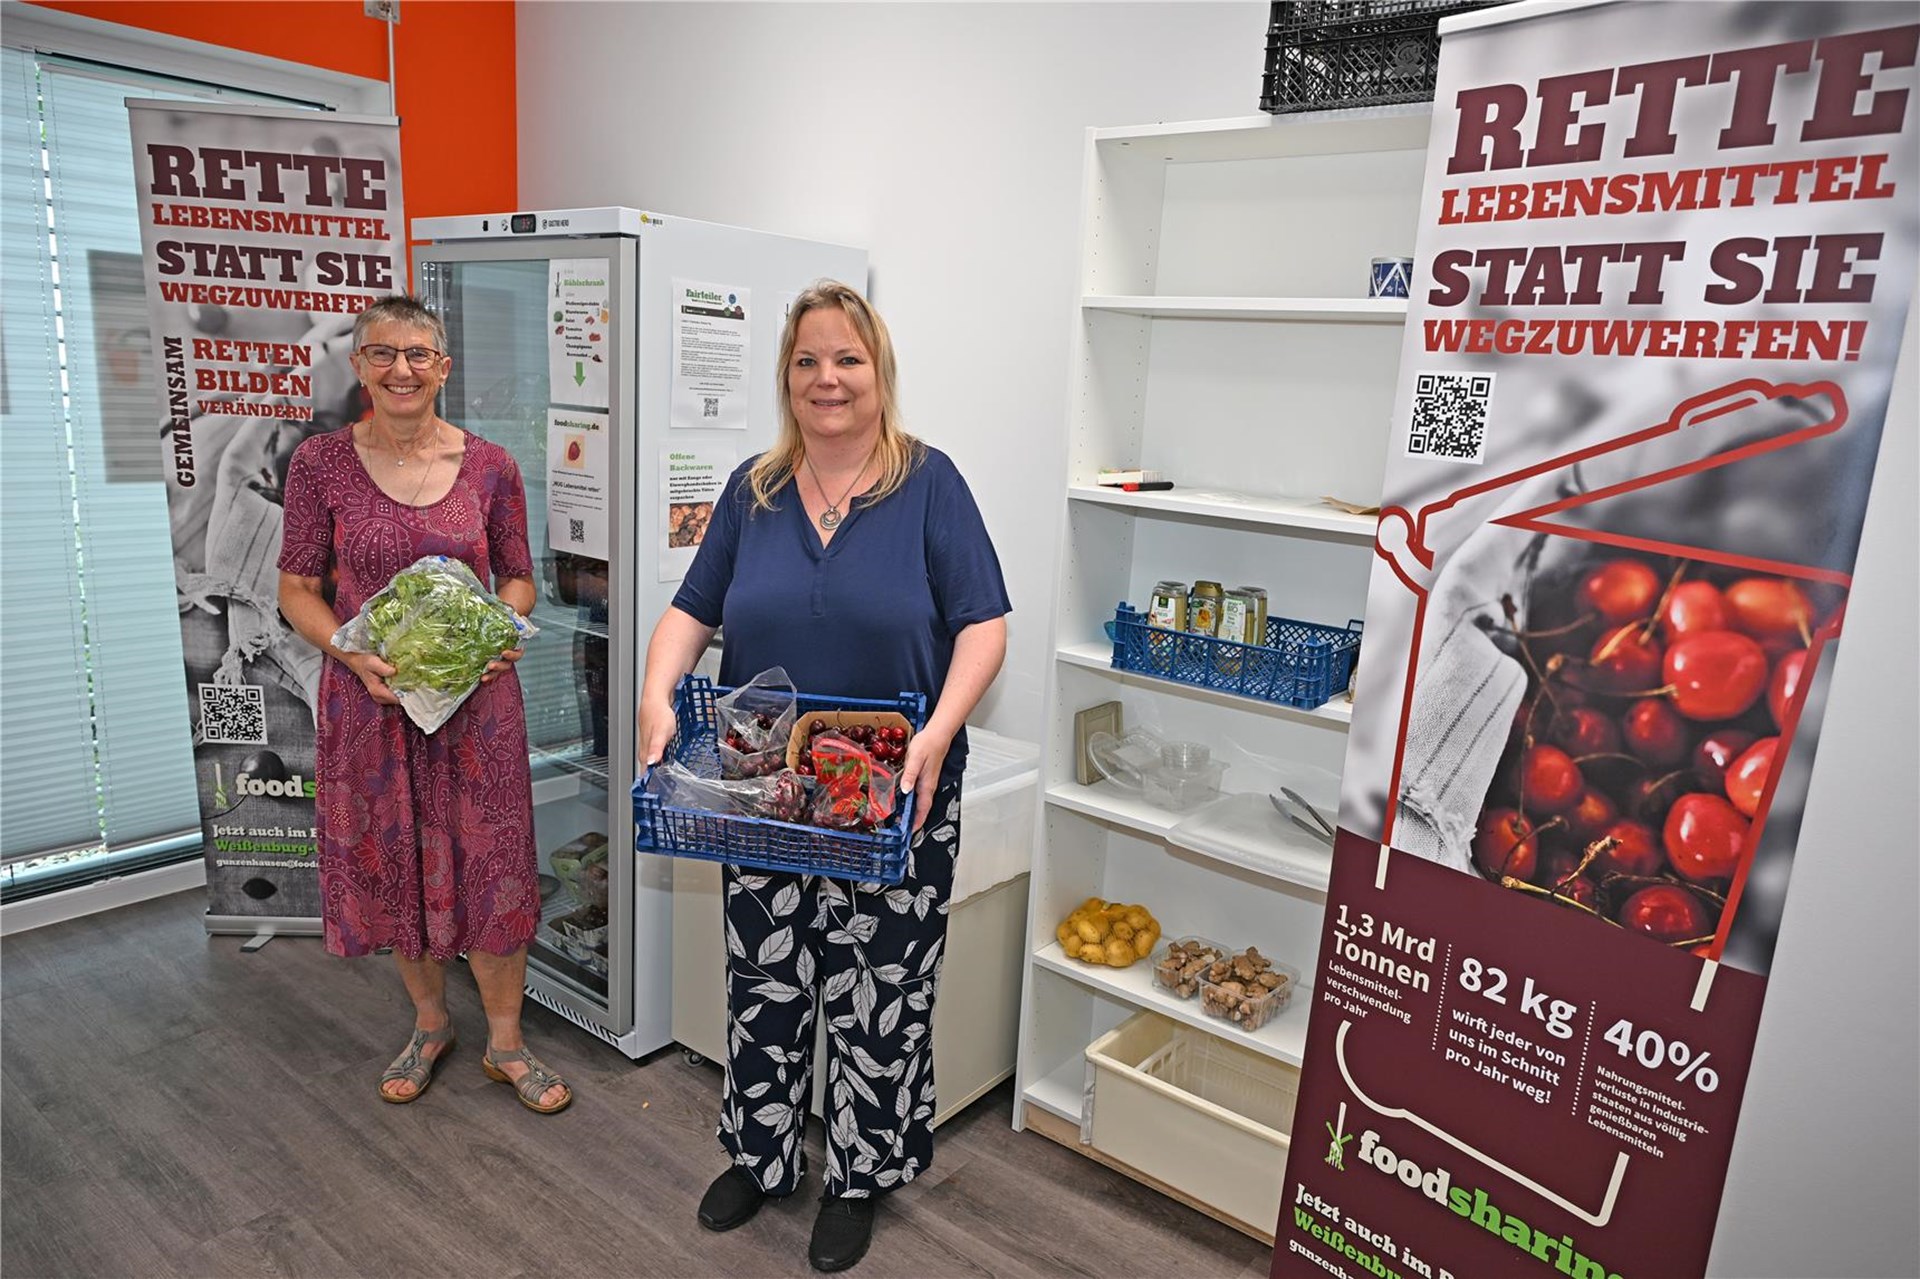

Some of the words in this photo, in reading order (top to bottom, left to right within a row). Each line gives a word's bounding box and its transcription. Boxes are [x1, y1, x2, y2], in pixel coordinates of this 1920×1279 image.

[1447, 24, 1920, 175] RETTE
[147, 144, 388, 211] RETTE
[1438, 153, 1896, 226] LEBENSMITTEL
[152, 203, 390, 241] LEBENSMITTEL
[156, 240, 303, 283] STATT
[316, 251, 393, 290] SIE
[1428, 241, 1686, 308] STATT
[1704, 233, 1884, 305] SIE
[192, 338, 312, 367] RETTEN
[1423, 319, 1868, 362] WEGZUWERFEN!
[195, 368, 312, 397] BILDEN
[163, 336, 196, 488] GEMEINSAM
[197, 397, 313, 421] VERÄNDERN
[554, 419, 599, 431] foodsharing.de
[670, 464, 713, 472] Backwaren
[236, 773, 316, 798] foods
[212, 824, 245, 838] Jetzt
[249, 826, 284, 838] auch
[288, 827, 307, 838] im
[1336, 904, 1374, 937] 1,3
[1381, 921, 1436, 963] Mrd
[1328, 959, 1402, 1000] Lebensmittel-
[1333, 930, 1430, 993] Tonnen
[1324, 991, 1341, 1006] pro
[1343, 1000, 1368, 1018] Jahr
[1326, 976, 1411, 1024] verschwendung
[1460, 958, 1508, 1005] 82
[1520, 977, 1577, 1039] kg
[1449, 1029, 1475, 1048] uns
[1478, 1039, 1498, 1059] im
[1501, 1050, 1560, 1086] Schnitt
[1452, 1009, 1488, 1033] wirft
[1488, 1023, 1533, 1051] jeder
[1535, 1045, 1566, 1067] von
[1603, 1019, 1719, 1093] 40%
[1445, 1048, 1471, 1066] pro
[1473, 1060, 1509, 1084] Jahr
[1512, 1078, 1551, 1104] weg!
[1596, 1065, 1686, 1111] Nahrungsmittel-
[1589, 1104, 1657, 1141] genießbaren
[1592, 1092, 1632, 1115] staaten
[1633, 1110, 1653, 1126] aus
[1655, 1120, 1687, 1143] völlig
[1594, 1079, 1638, 1104] verluste
[1639, 1098, 1650, 1110] in
[1652, 1104, 1709, 1134] Industrie-
[1587, 1115, 1664, 1158] Lebensmitteln
[1358, 1130, 1624, 1279] foodsharin
[1296, 1183, 1340, 1223] Jetzt
[1344, 1216, 1397, 1258] auch
[1401, 1247, 1432, 1279] im
